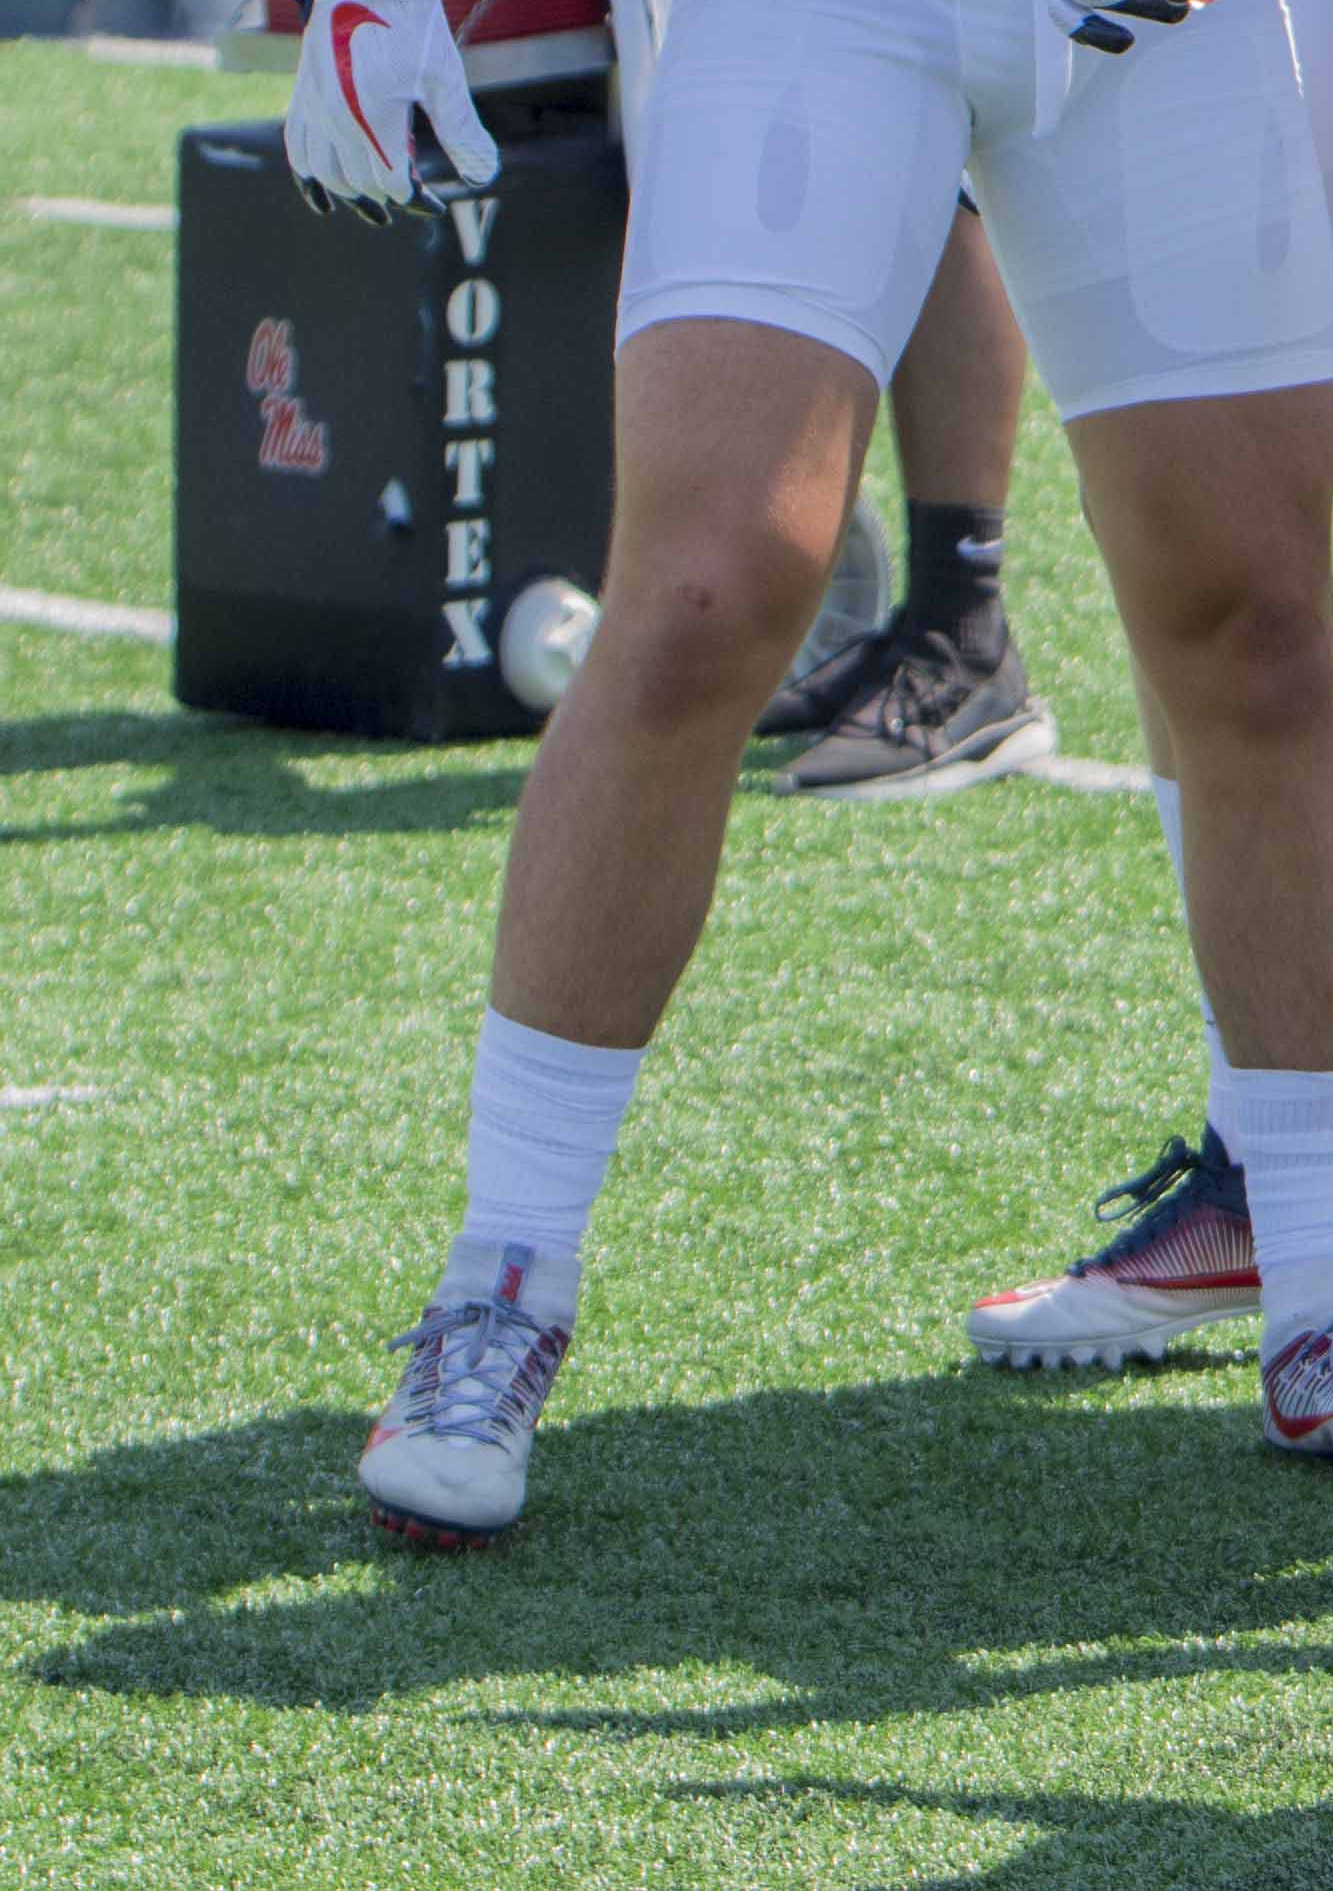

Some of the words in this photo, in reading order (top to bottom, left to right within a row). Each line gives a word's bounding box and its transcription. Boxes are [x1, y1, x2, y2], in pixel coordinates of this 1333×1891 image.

[246, 316, 295, 393] Ole
[258, 394, 329, 475] Miss
[442, 198, 501, 670] VORTEX
